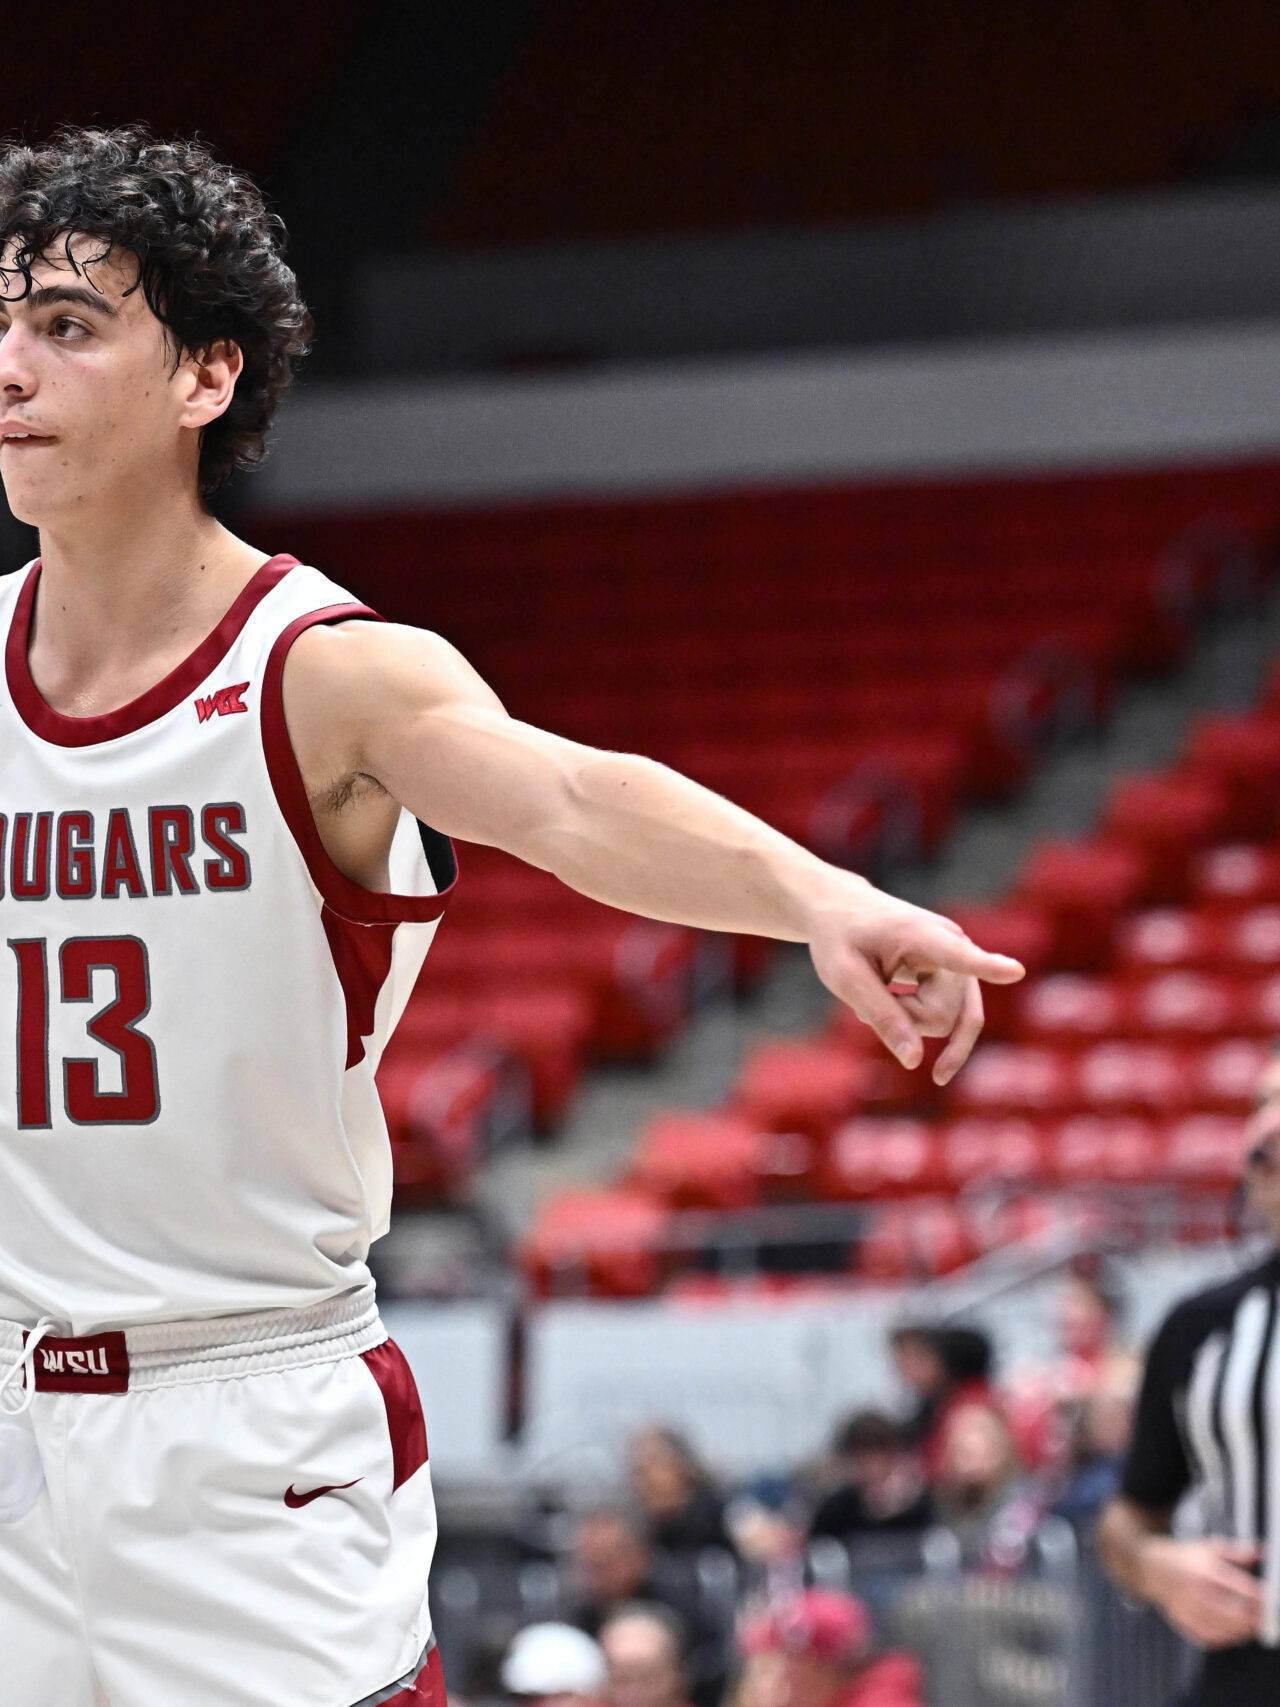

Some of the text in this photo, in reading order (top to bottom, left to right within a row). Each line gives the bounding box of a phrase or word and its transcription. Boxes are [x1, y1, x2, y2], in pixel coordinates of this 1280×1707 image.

[194, 681, 250, 724] WCC
[7, 934, 161, 1130] 13
[39, 1347, 109, 1375] WSU
